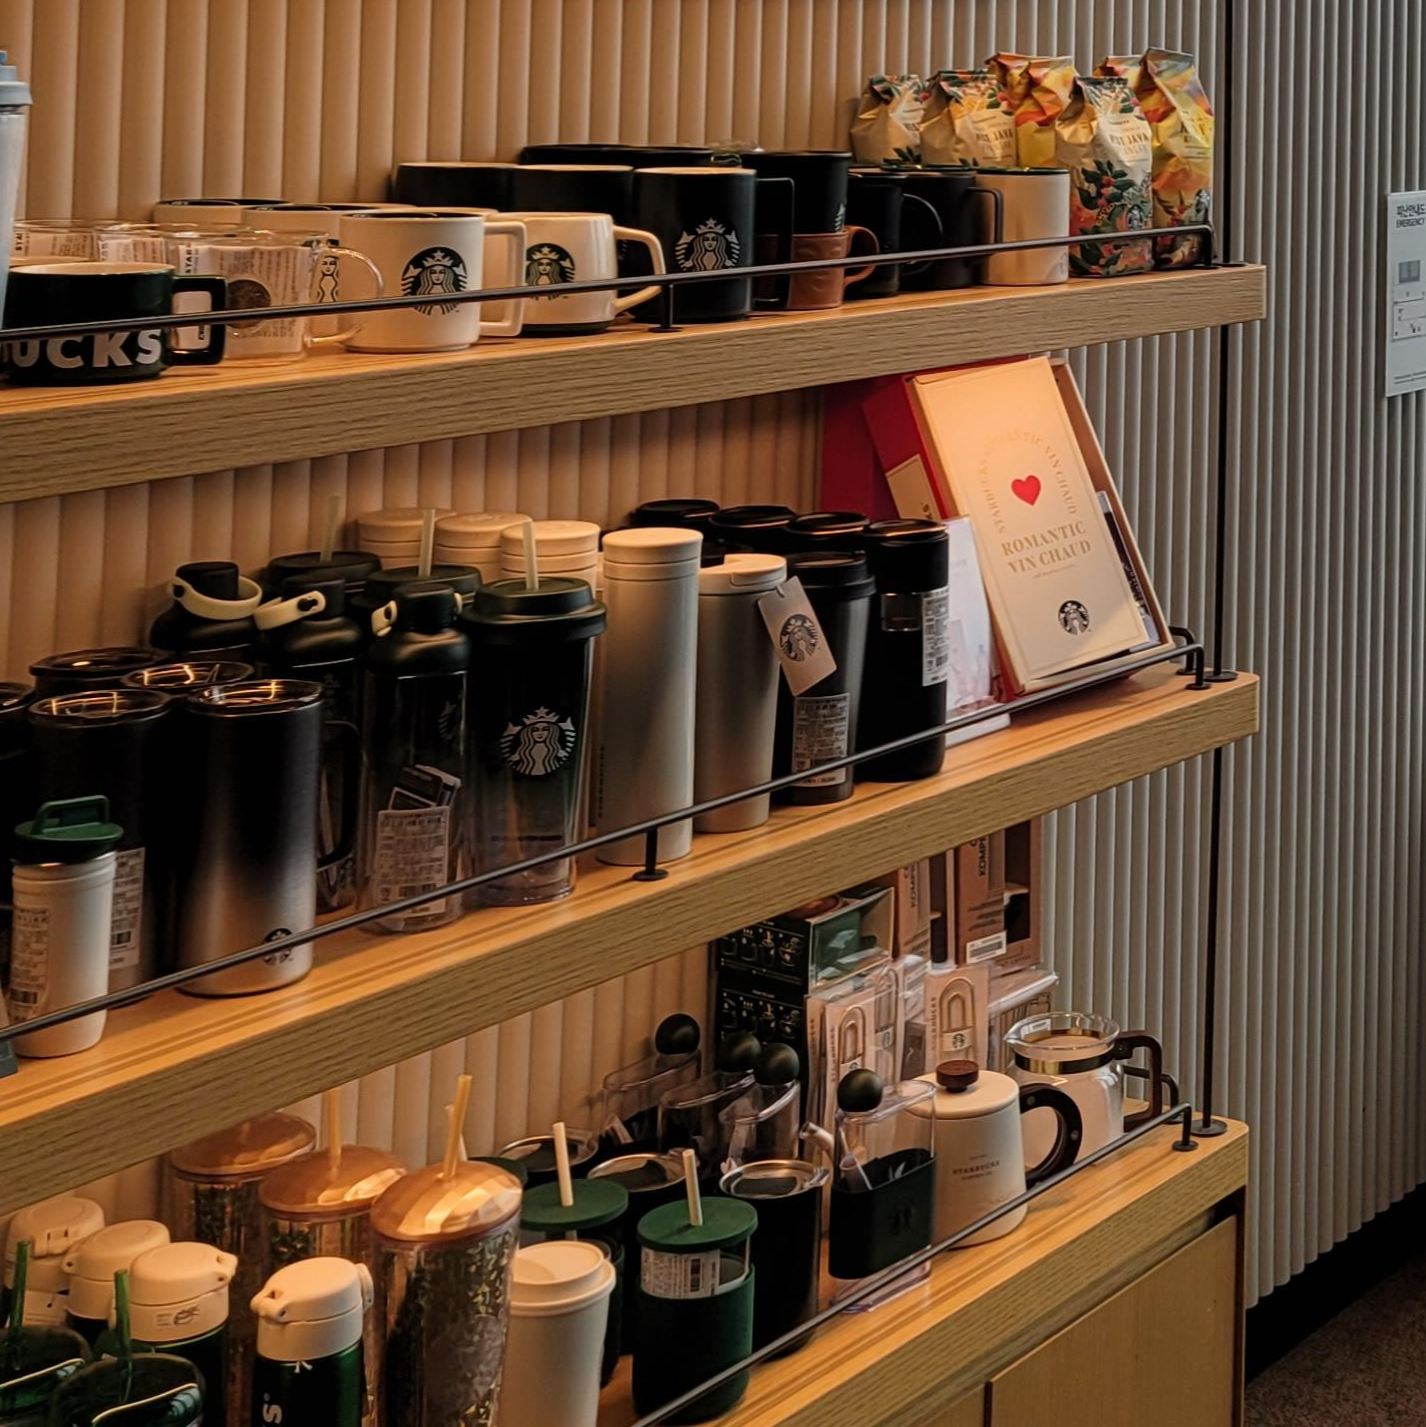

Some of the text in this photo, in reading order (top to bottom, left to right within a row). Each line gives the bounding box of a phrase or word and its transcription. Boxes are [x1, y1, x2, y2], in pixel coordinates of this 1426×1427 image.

[1126, 132, 1150, 145] JAVA
[2, 328, 163, 369] UCKS
[1001, 520, 1087, 557] ROMANTIC
[1007, 539, 1092, 574] VIN CHAUD
